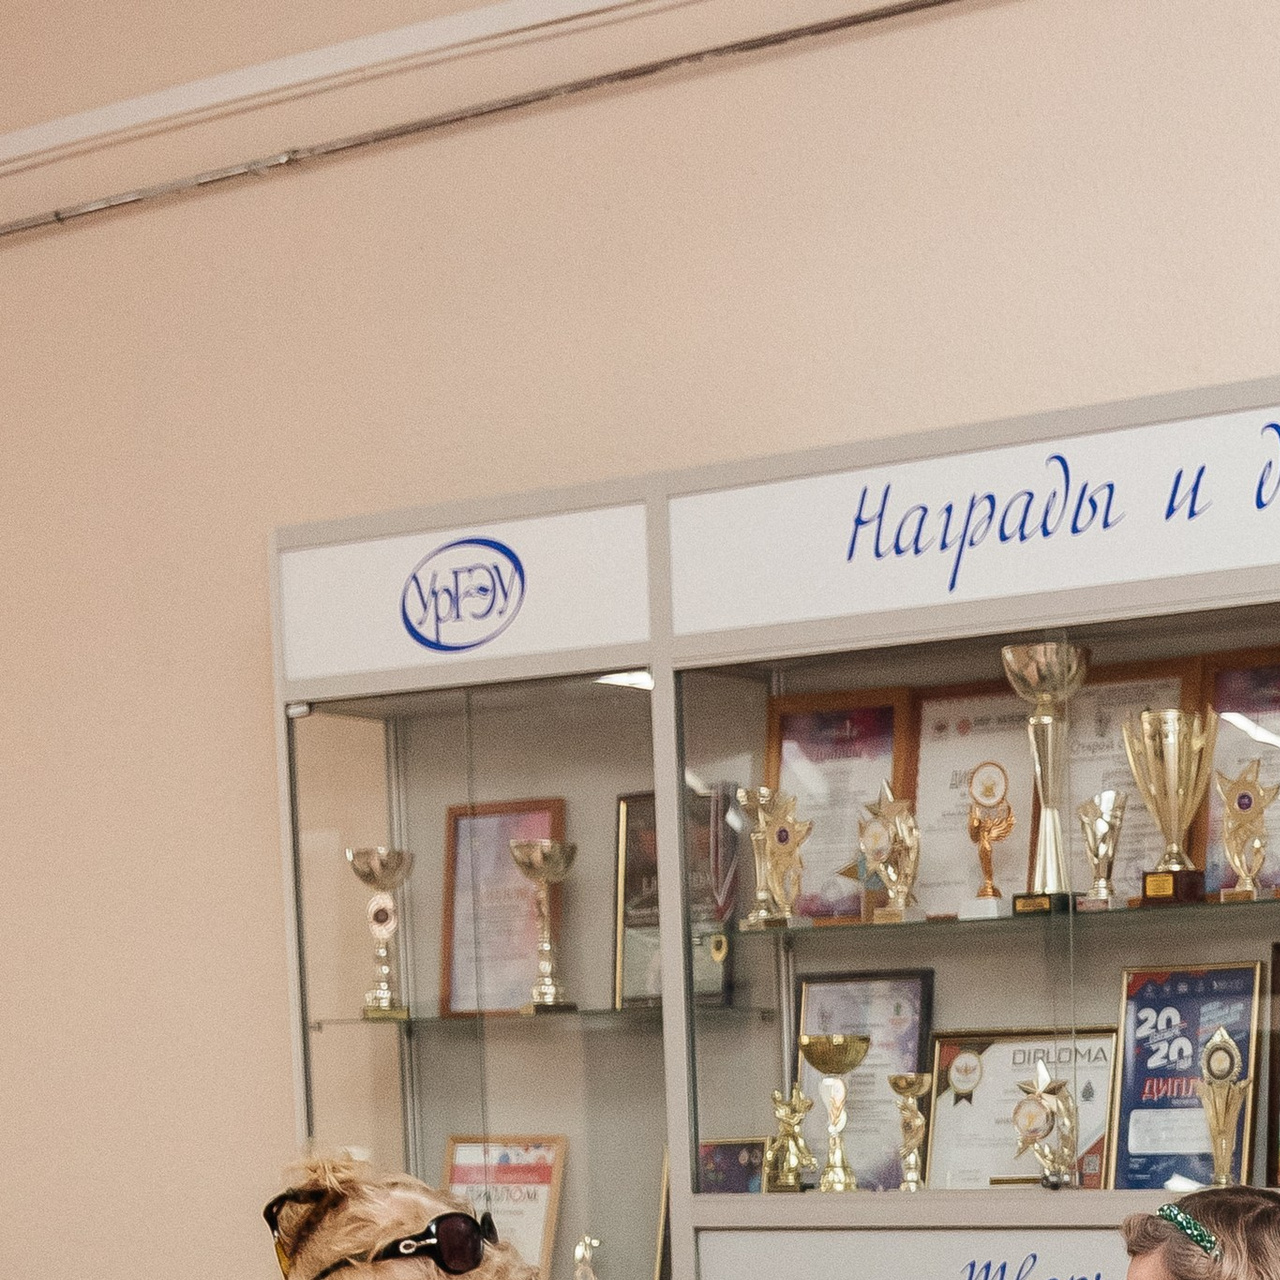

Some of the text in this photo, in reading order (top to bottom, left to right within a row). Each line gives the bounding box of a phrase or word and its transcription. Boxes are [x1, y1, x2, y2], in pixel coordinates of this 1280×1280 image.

[846, 453, 1125, 591] Награды
[1164, 463, 1211, 522] и
[411, 563, 517, 645] УрГЭУ
[1135, 1006, 1181, 1039] 20
[1012, 1046, 1108, 1065] DIPLOMA
[1146, 1036, 1194, 1071] 20
[1141, 1076, 1200, 1102] ДИПЛ
